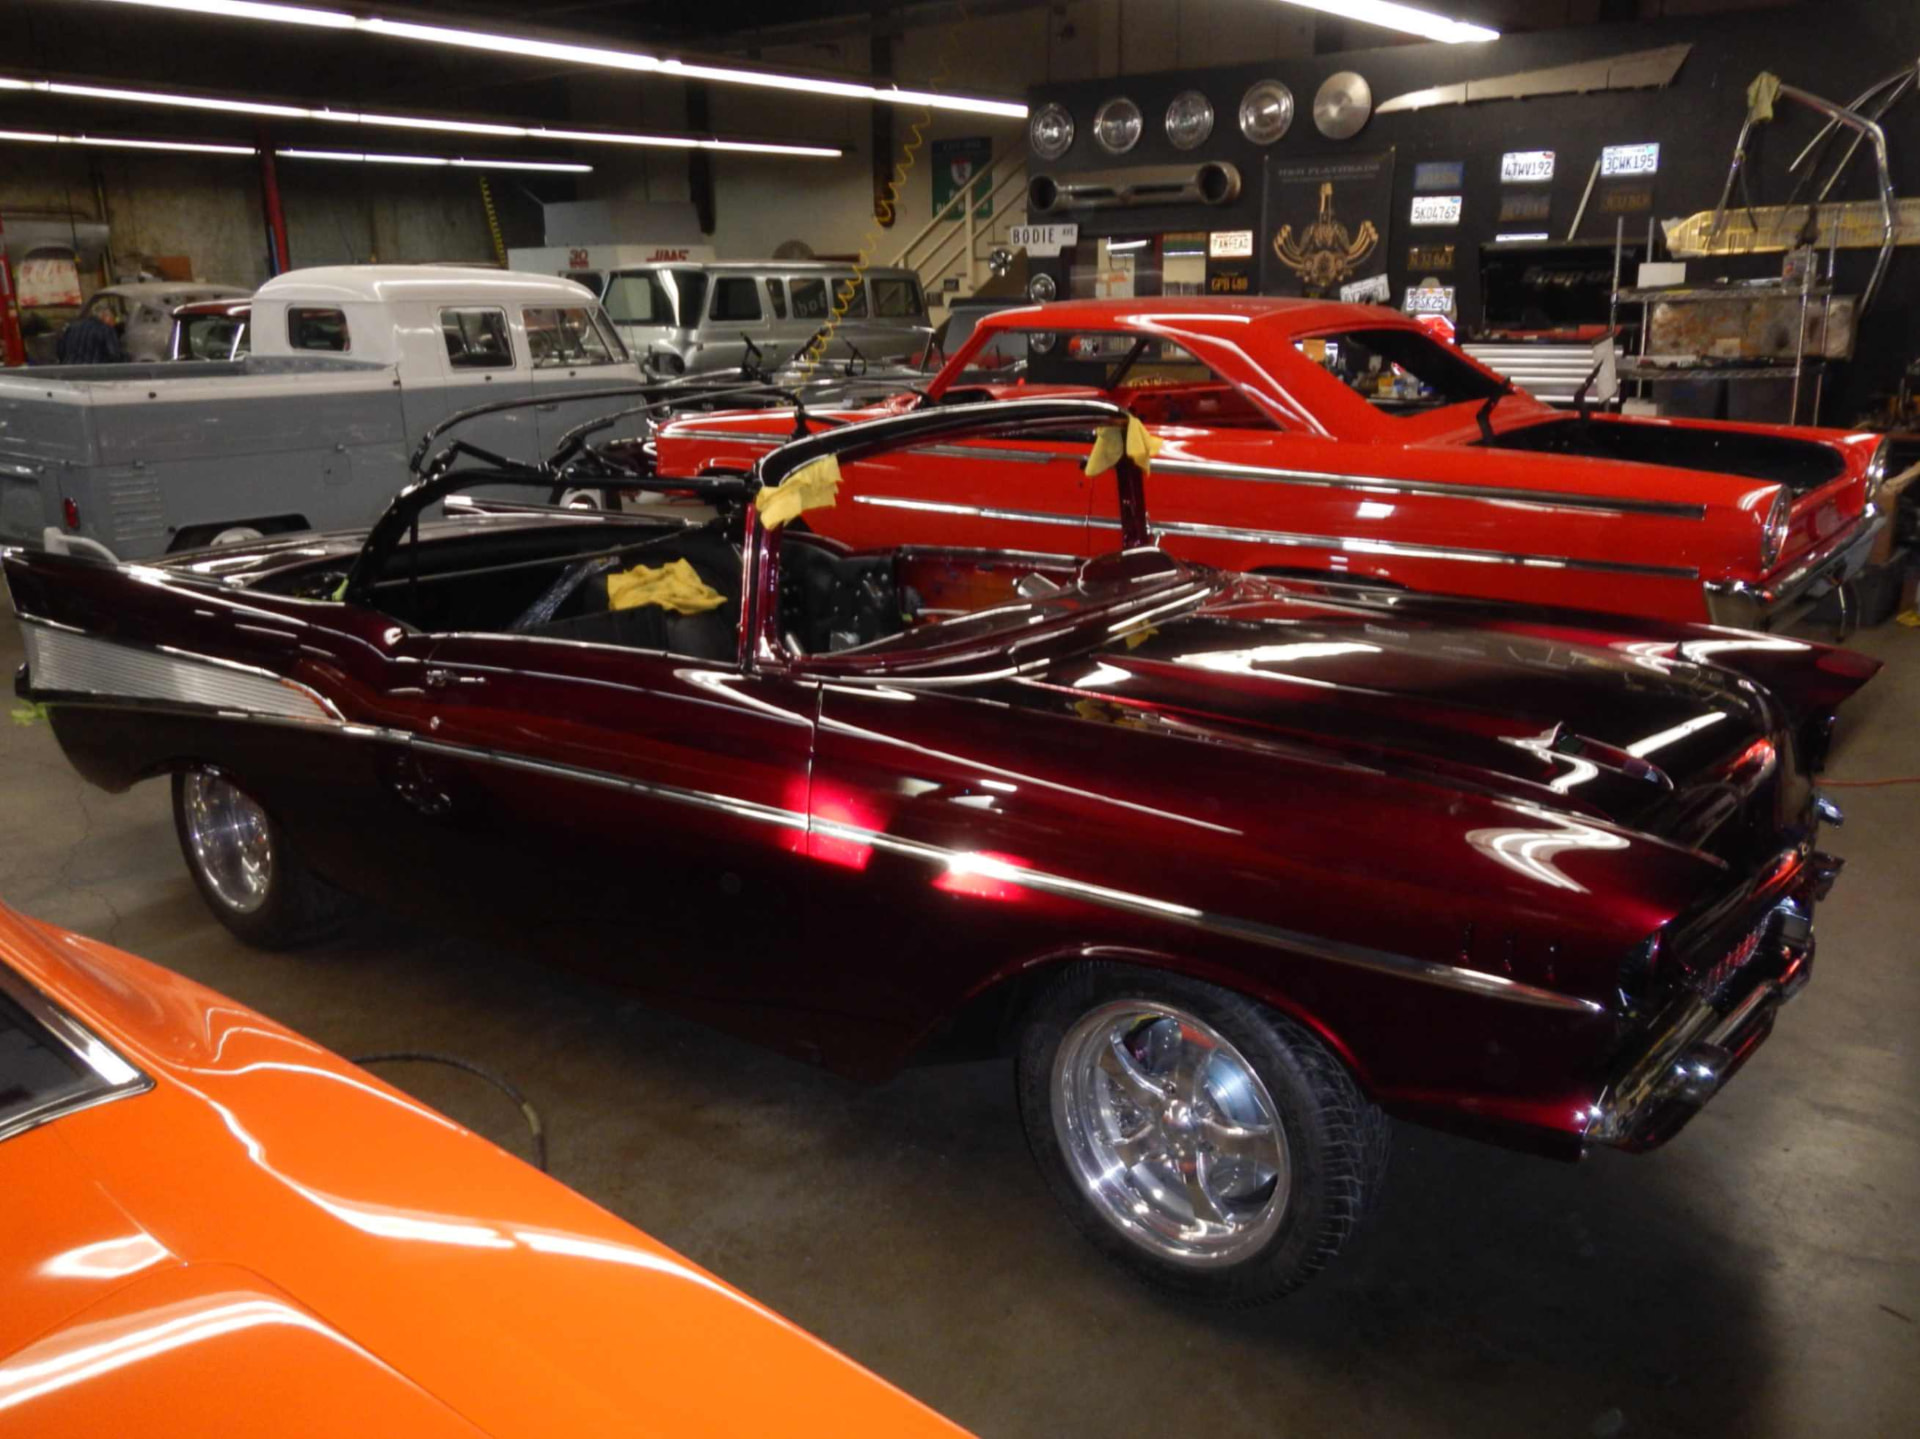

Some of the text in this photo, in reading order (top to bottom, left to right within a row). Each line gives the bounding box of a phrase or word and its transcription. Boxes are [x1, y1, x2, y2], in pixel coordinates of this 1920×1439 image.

[1504, 161, 1550, 176] 4TWV192
[1604, 153, 1654, 171] 3CWK195
[1013, 227, 1055, 244] BODIE
